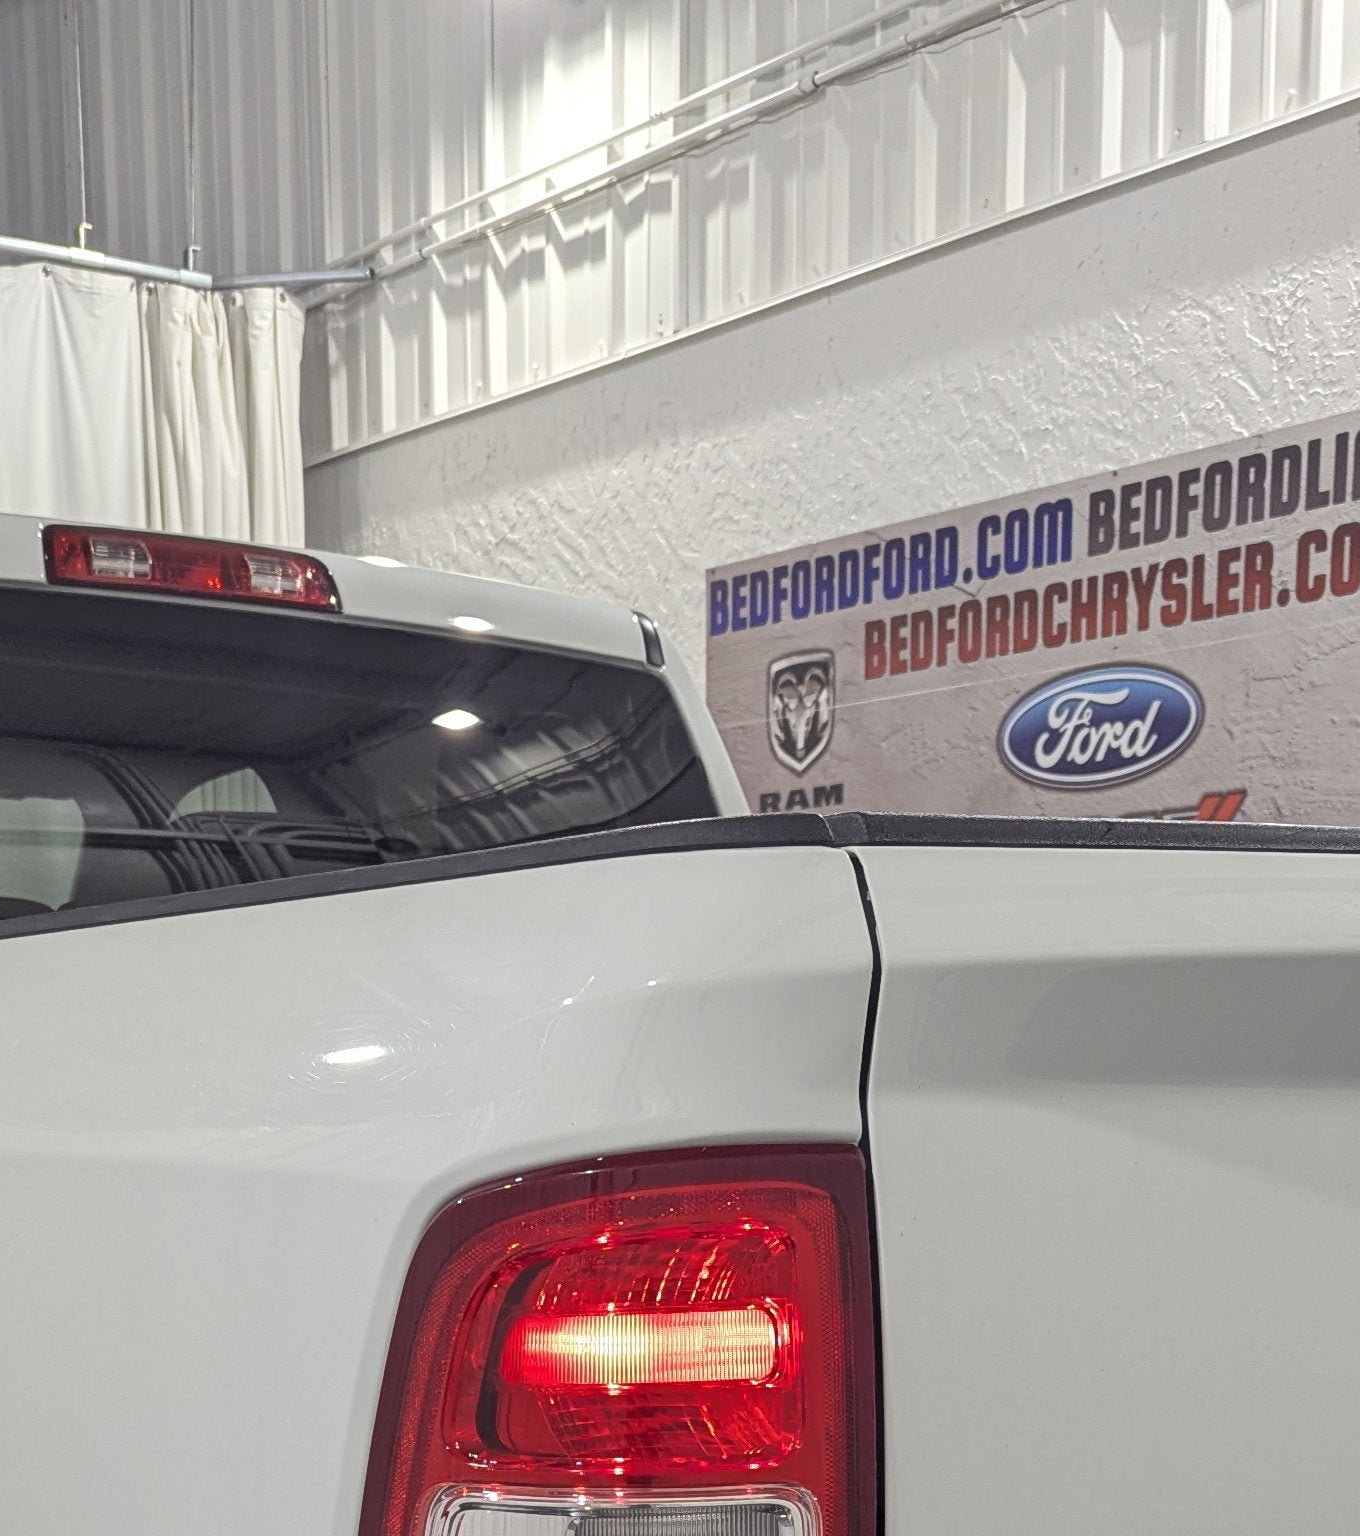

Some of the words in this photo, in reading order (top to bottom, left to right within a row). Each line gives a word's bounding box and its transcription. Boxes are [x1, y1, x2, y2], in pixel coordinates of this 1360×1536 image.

[710, 498, 1073, 636] BEDFORDFORD.COM
[1035, 692, 1161, 765] Ford
[759, 783, 845, 815] RAM
